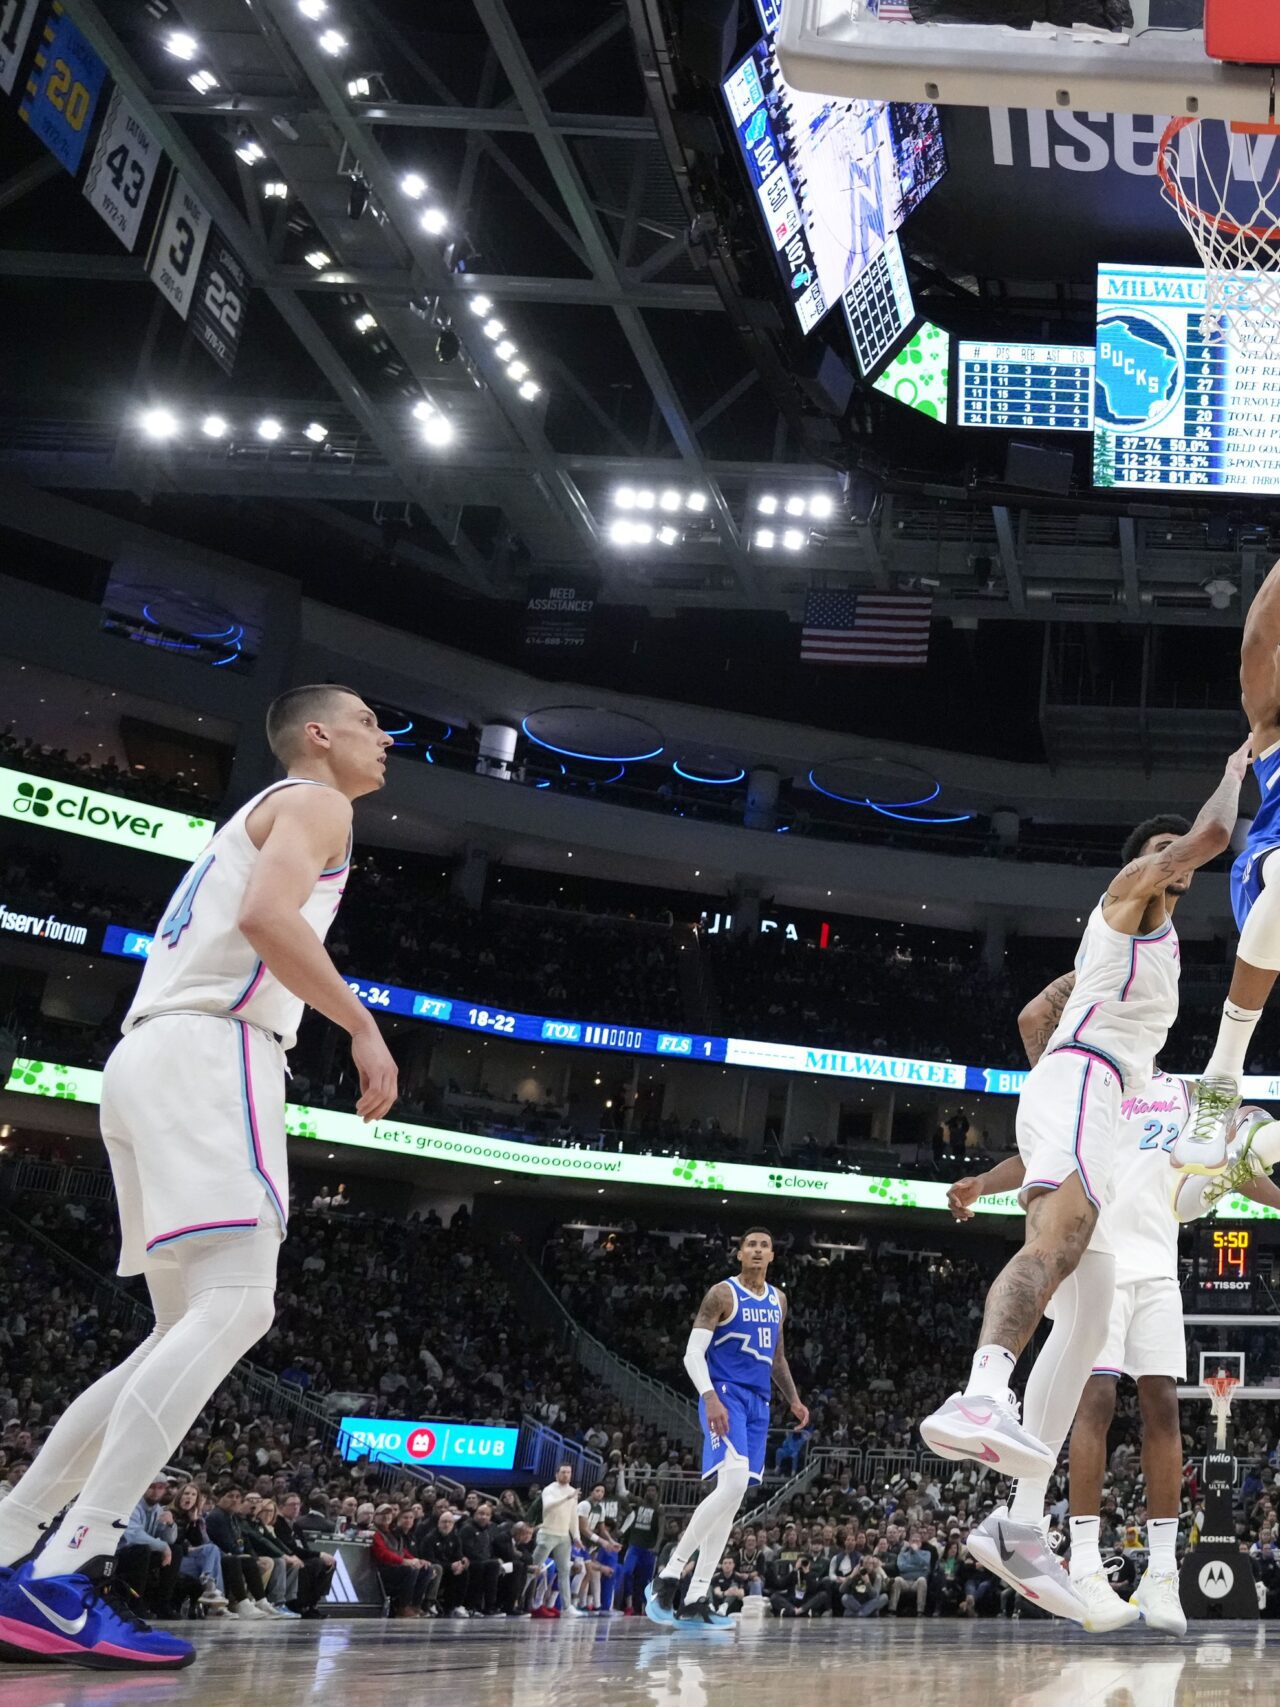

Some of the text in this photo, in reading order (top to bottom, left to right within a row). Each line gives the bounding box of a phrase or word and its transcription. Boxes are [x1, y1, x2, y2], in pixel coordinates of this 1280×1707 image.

[46, 57, 90, 132] 20
[126, 116, 150, 155] TATUM
[754, 136, 778, 180] 104
[106, 144, 146, 209] 43
[767, 176, 789, 214] 5:50
[169, 216, 196, 278] 3
[785, 233, 807, 273] 102
[205, 271, 242, 339] 22
[1202, 347, 1211, 360] 4
[997, 364, 1081, 377] 23 3 2
[1100, 342, 1159, 394] BUCKS
[1201, 363, 1211, 375] 6
[1235, 365, 1256, 375] OFF
[973, 375, 1081, 389] 3 11 3 2 1
[1196, 378, 1214, 392] 27
[1235, 380, 1257, 391] DEF
[971, 388, 1081, 402] 11 3 1 2
[1201, 394, 1209, 407] 8
[997, 402, 1080, 414] 13 3 4
[1196, 409, 1213, 423] 20
[1228, 411, 1265, 422] TOTAL
[970, 413, 1080, 427] 34 17 2
[1196, 425, 1212, 438] 34
[1227, 427, 1266, 438] BENCH
[1122, 437, 1162, 452] 37-74
[1169, 439, 1210, 453] 50.0%
[1226, 443, 1256, 453] FIELD
[1122, 453, 1162, 467] 12-34
[1169, 454, 1209, 469] 35.3%
[1122, 469, 1161, 483] 18-22
[1169, 470, 1209, 485] 81.8%
[1225, 474, 1247, 484] FREE
[549, 587, 576, 600] NEED
[528, 598, 594, 612] ASSISTANCE?
[56, 795, 164, 839] clover
[419, 999, 446, 1017] FT
[468, 1008, 516, 1034] 18-22
[546, 1022, 579, 1041] TOL
[659, 1036, 690, 1052] FLS
[704, 1041, 713, 1057] 1
[805, 1050, 958, 1085] MILWAUKEE
[1121, 1096, 1181, 1121] Miami
[373, 1125, 412, 1145] Let's
[1139, 1119, 1179, 1153] 22
[784, 1174, 829, 1191] clover
[1213, 1231, 1249, 1248] 5:50
[1218, 1248, 1244, 1277] 14
[1213, 1281, 1251, 1290] TISSOT
[742, 1307, 780, 1324] BUCKS
[757, 1326, 772, 1349] 18
[350, 1430, 505, 1456] BMO CLUB
[1209, 1453, 1232, 1464] wilo
[1200, 1535, 1236, 1544] KOHL'S
